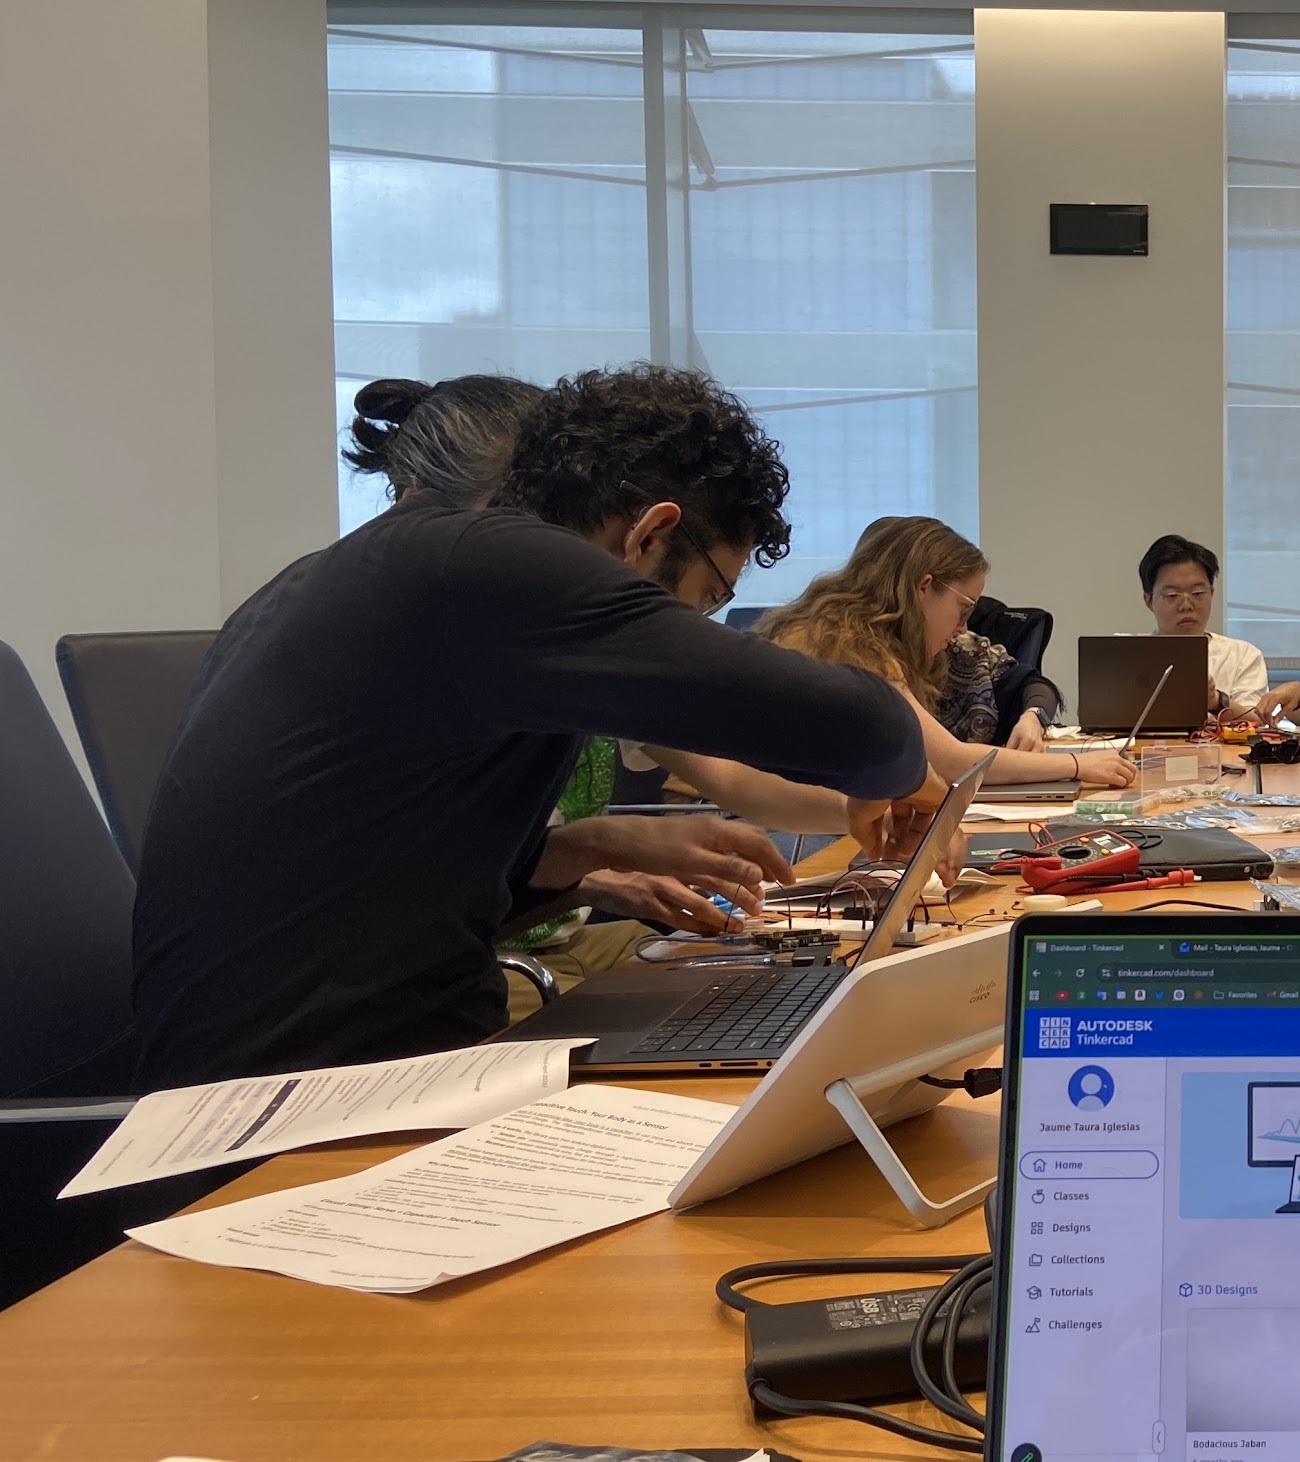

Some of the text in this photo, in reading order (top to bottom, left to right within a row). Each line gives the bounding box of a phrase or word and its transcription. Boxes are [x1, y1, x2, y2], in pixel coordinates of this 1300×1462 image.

[1050, 944, 1125, 952] Dashboard Tinkercad
[1193, 944, 1209, 952] Mail
[1214, 944, 1231, 952] Taura
[1260, 944, 1281, 952] Jaume
[1117, 968, 1215, 978] tinkercad.com/dashboard
[969, 991, 991, 1004] cisco
[1228, 990, 1258, 999] Favorites
[1279, 990, 1299, 999] Gmail
[1076, 1019, 1154, 1032] AUTODESK
[1076, 1033, 1134, 1045] Tinkercad
[1039, 1121, 1141, 1134] Jaume Taura Iglesias
[1054, 1160, 1083, 1170] Home
[1053, 1191, 1090, 1202] Classes
[1052, 1222, 1091, 1235] Designs
[1050, 1254, 1105, 1265] Collections
[1049, 1286, 1094, 1297] Tutorials
[1197, 1284, 1258, 1298] 3D Designs
[860, 1297, 880, 1314] USB
[1048, 1319, 1103, 1332] Challenges
[1193, 1440, 1267, 1448] Bodacious Jaban
